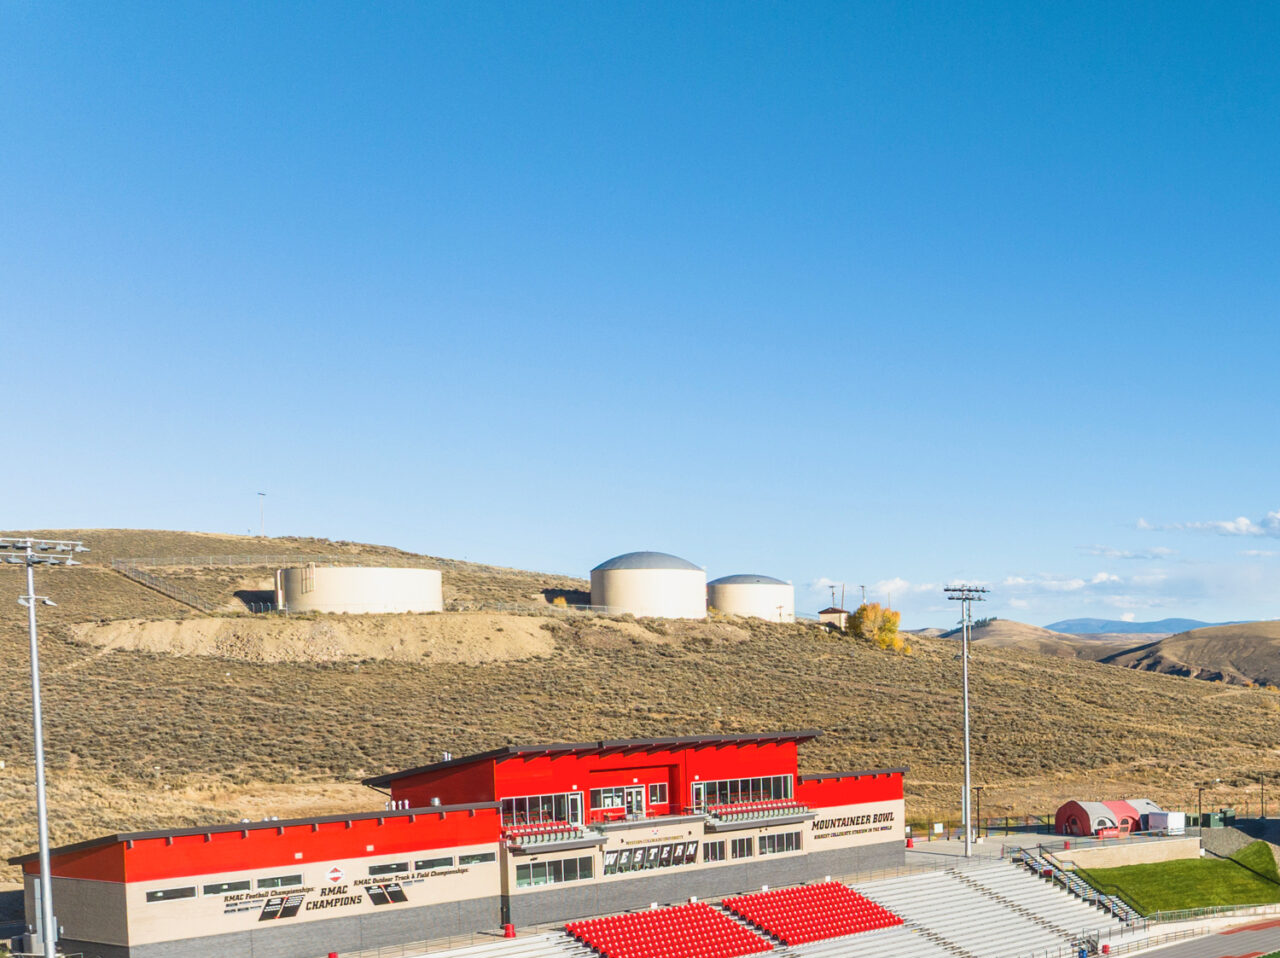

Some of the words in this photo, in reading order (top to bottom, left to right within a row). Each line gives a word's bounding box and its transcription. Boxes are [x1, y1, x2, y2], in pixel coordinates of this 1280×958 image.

[811, 815, 871, 831] MOUNTAINEER
[872, 812, 894, 824] BOWL
[605, 843, 697, 866] WESTERN
[320, 885, 348, 897] RMAC
[306, 895, 362, 911] CHAMPIONS
